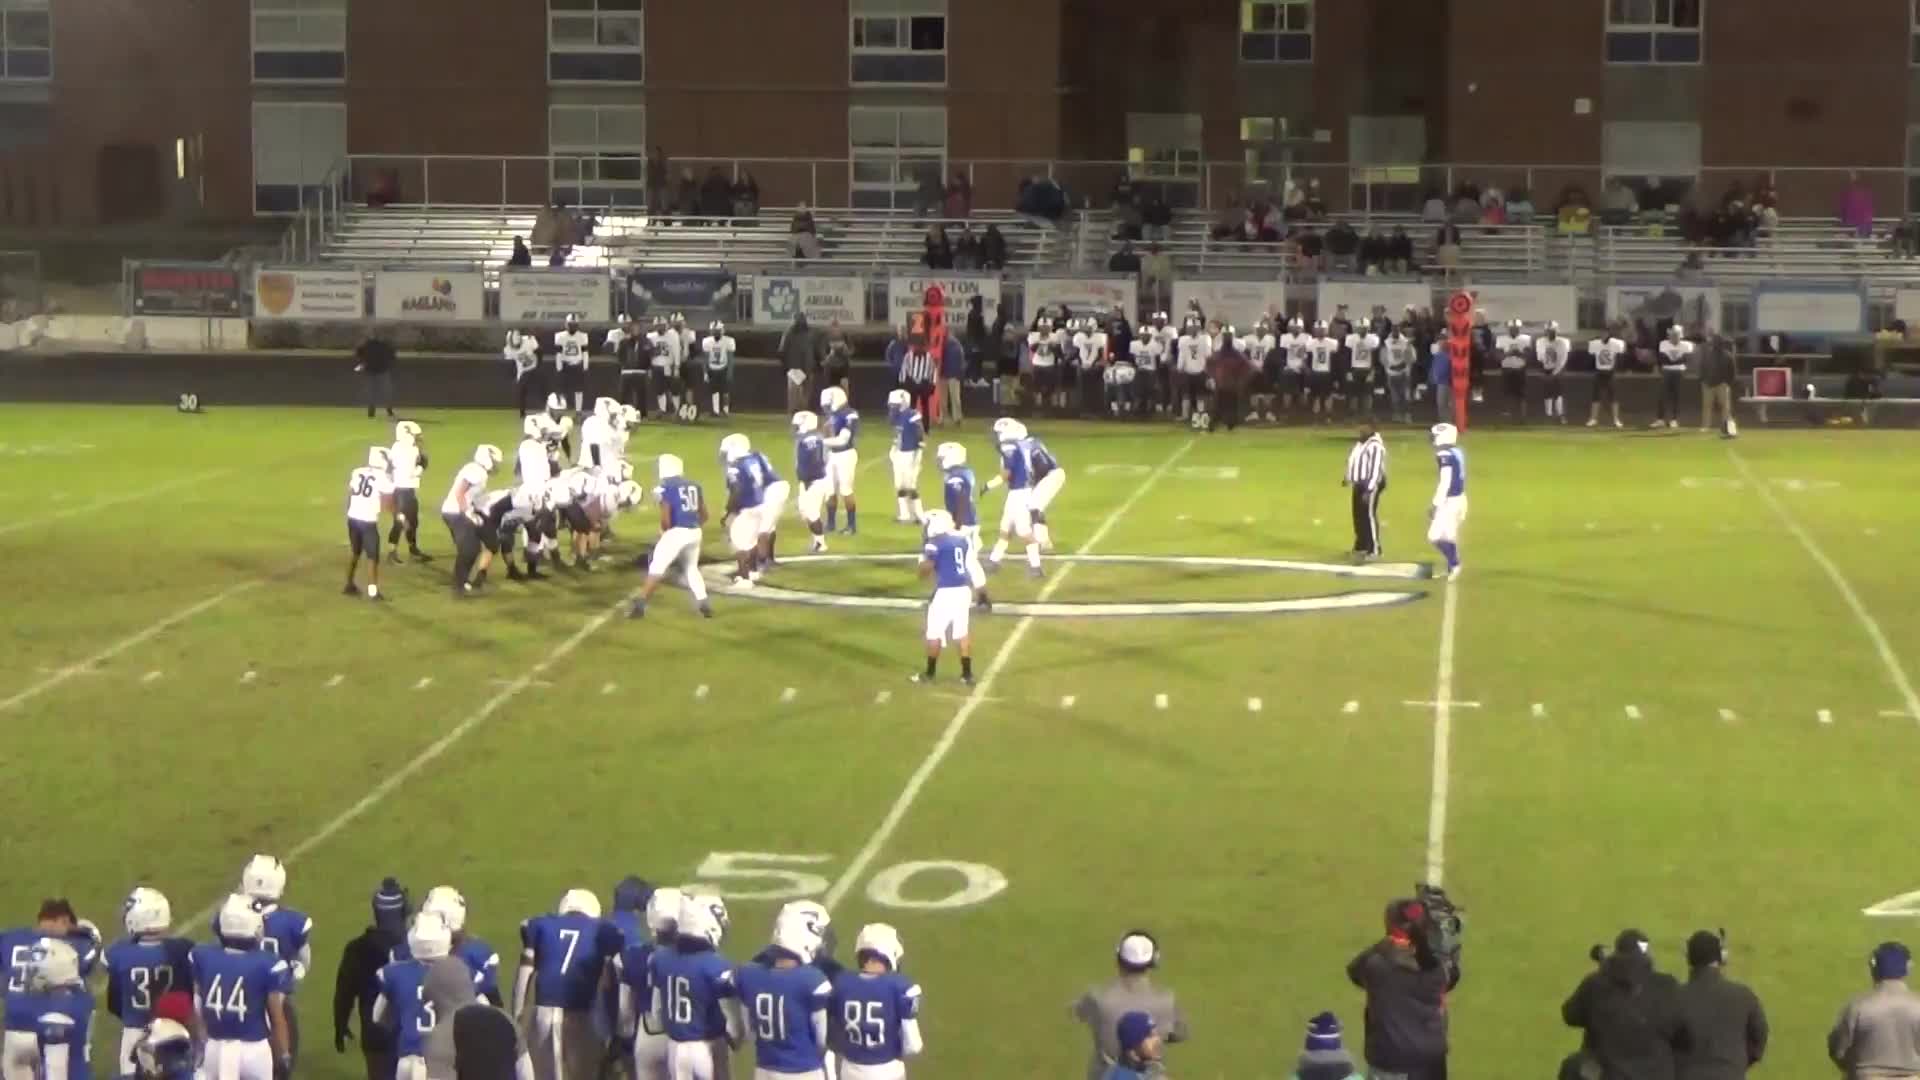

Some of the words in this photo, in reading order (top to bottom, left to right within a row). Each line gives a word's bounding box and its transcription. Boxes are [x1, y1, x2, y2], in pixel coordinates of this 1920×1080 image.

[910, 281, 980, 293] CLYTON
[180, 394, 197, 410] 30
[679, 404, 697, 420] 40
[352, 473, 375, 498] 36
[678, 485, 699, 512] 50
[954, 547, 965, 574] 9
[695, 851, 1009, 909] 50
[559, 929, 580, 976] 7
[205, 972, 247, 1023] 44
[666, 976, 692, 1024] 16
[755, 993, 786, 1041] 91
[844, 1000, 885, 1047] 85
